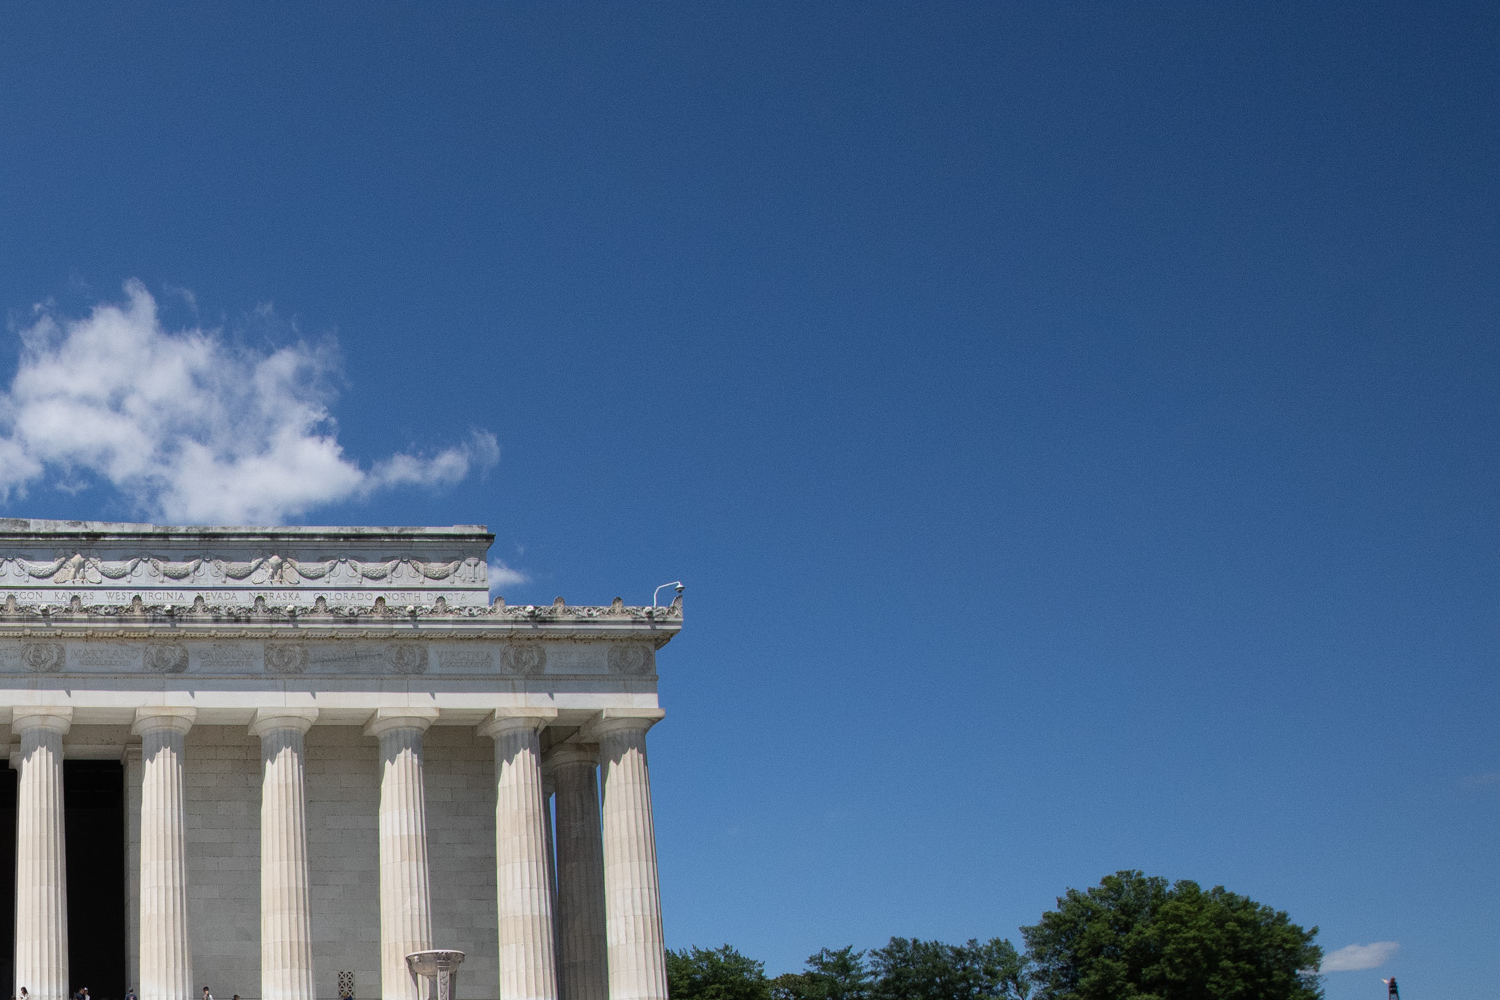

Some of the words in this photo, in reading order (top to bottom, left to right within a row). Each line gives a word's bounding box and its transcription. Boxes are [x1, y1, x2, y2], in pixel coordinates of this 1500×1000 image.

[105, 591, 133, 601] WEST
[313, 592, 373, 601] COLORADO
[384, 592, 421, 602] NORTH
[70, 648, 139, 660] MARYLAND
